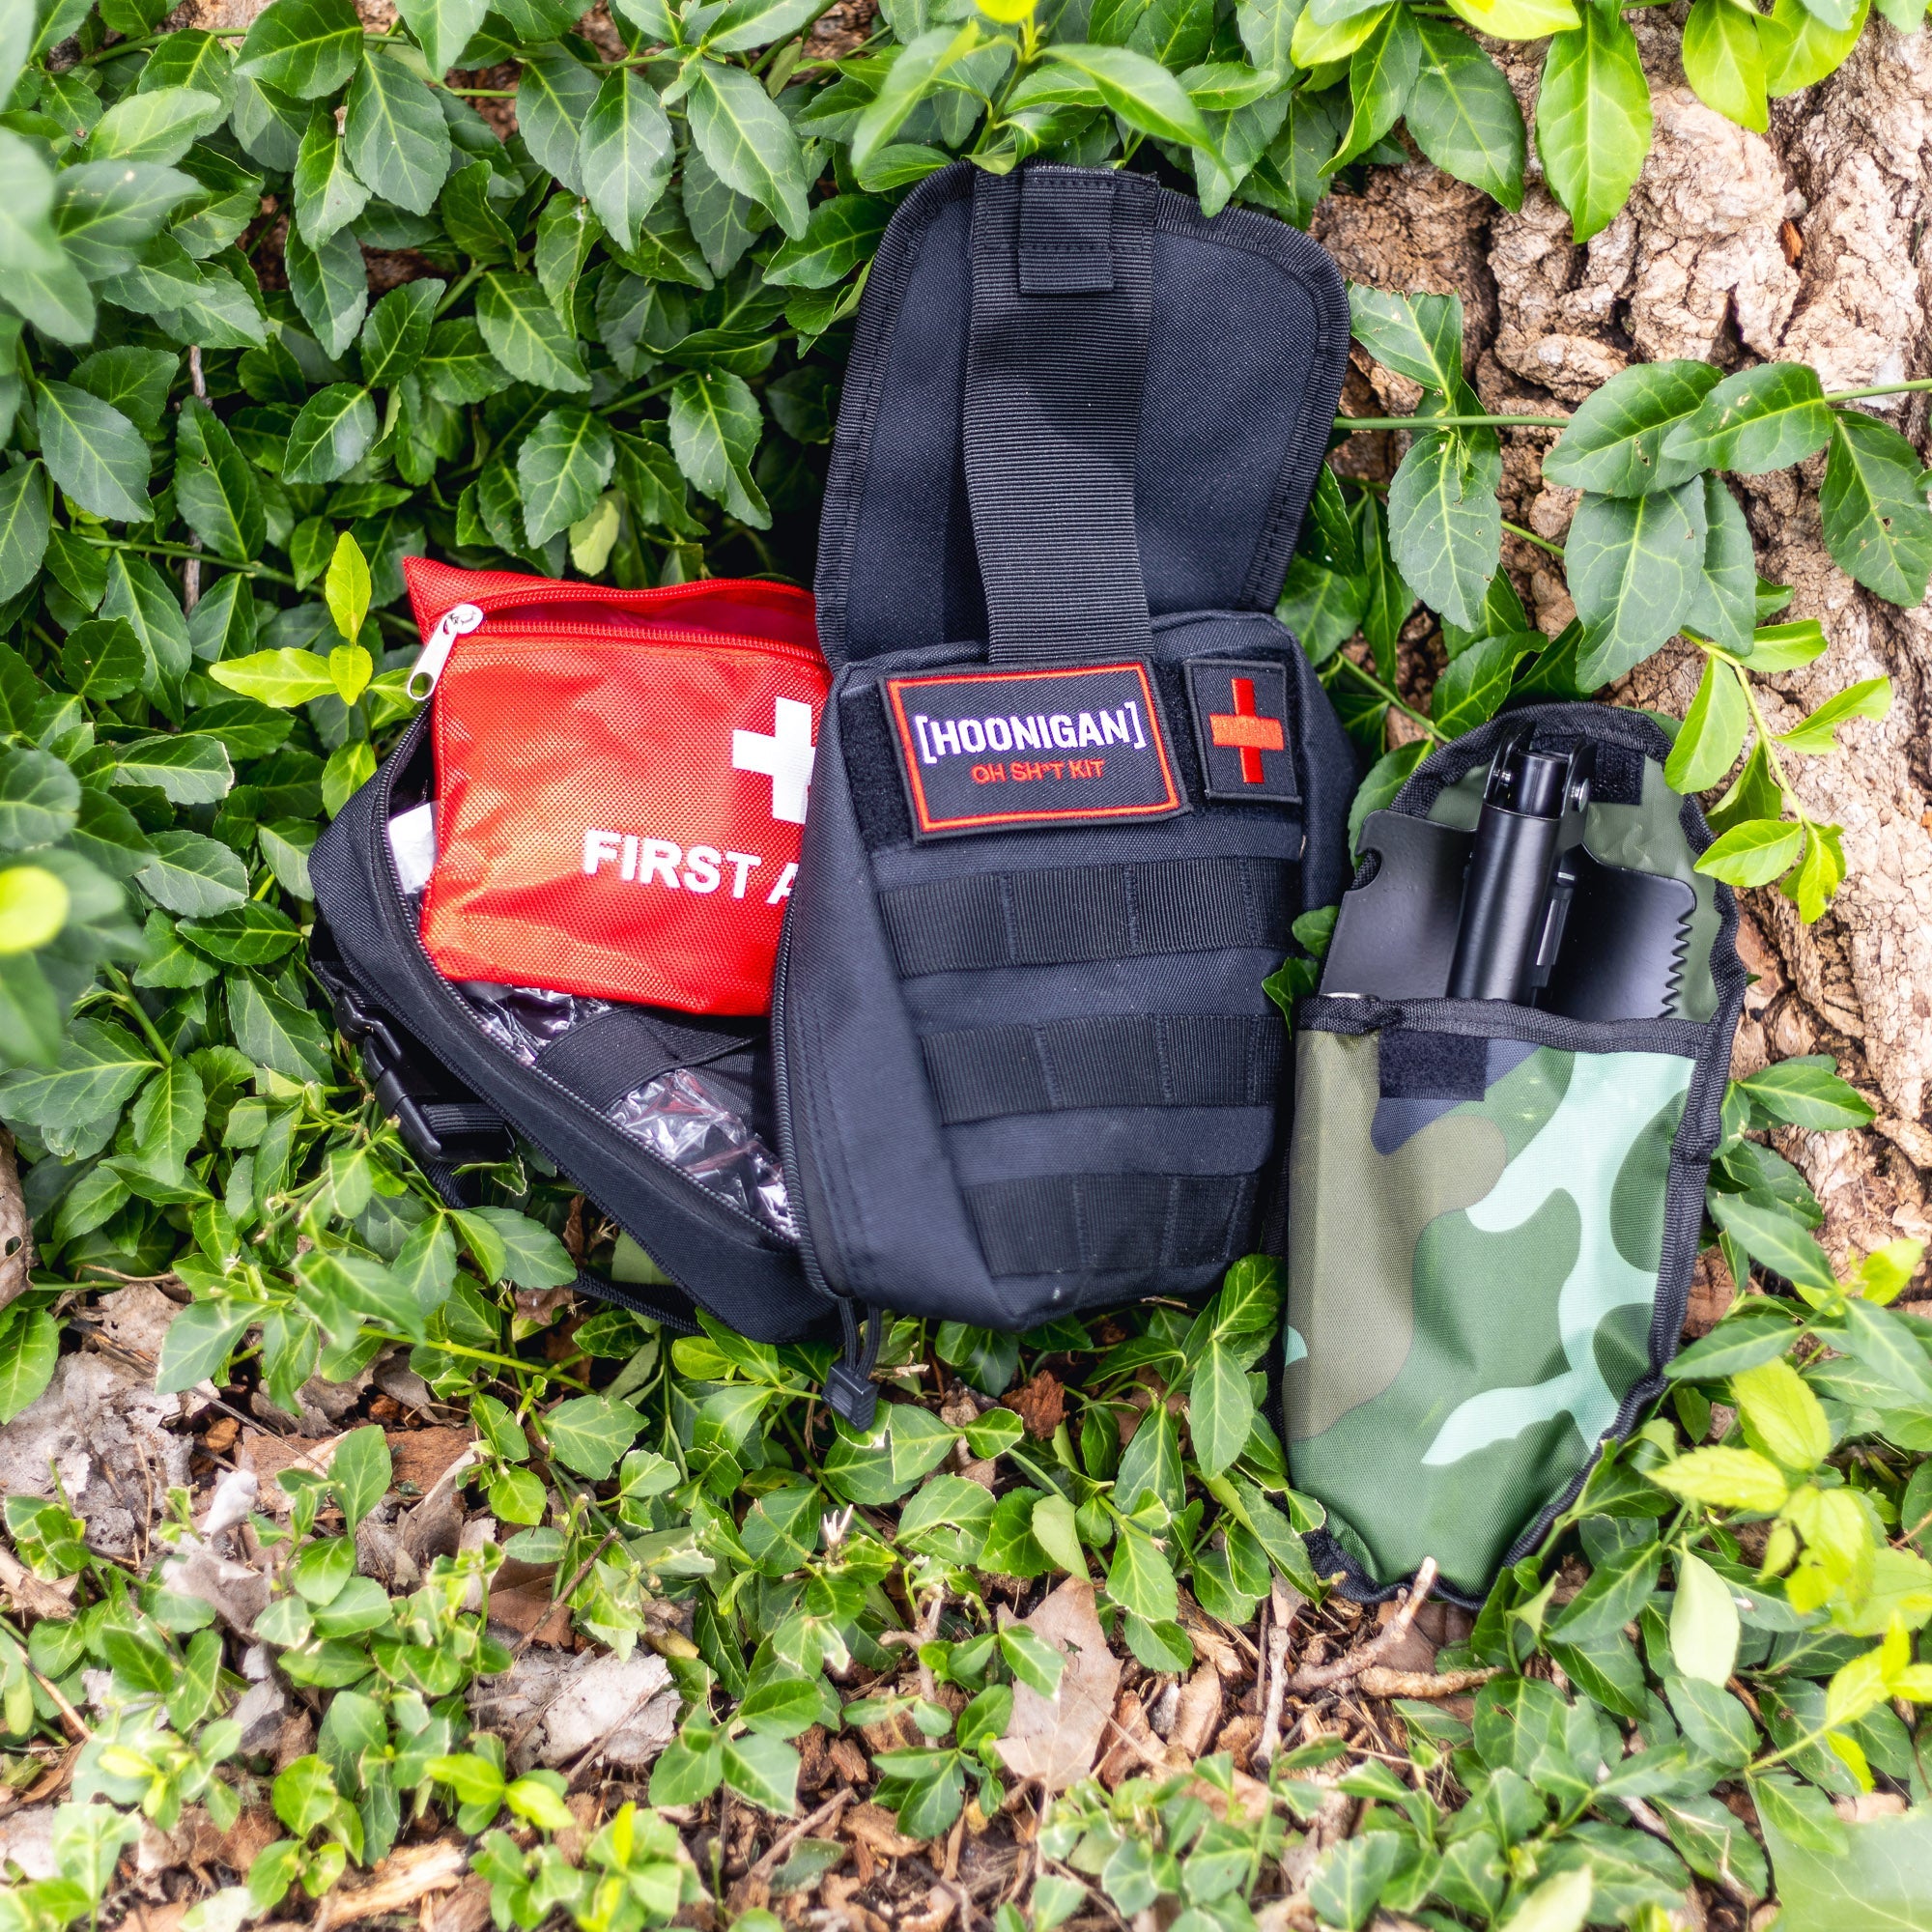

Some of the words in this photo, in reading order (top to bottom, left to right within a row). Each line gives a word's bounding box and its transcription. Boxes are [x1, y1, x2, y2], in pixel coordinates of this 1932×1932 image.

[971, 762, 1007, 784] OH
[1068, 757, 1105, 779] KIT
[583, 829, 761, 899] FIRST
